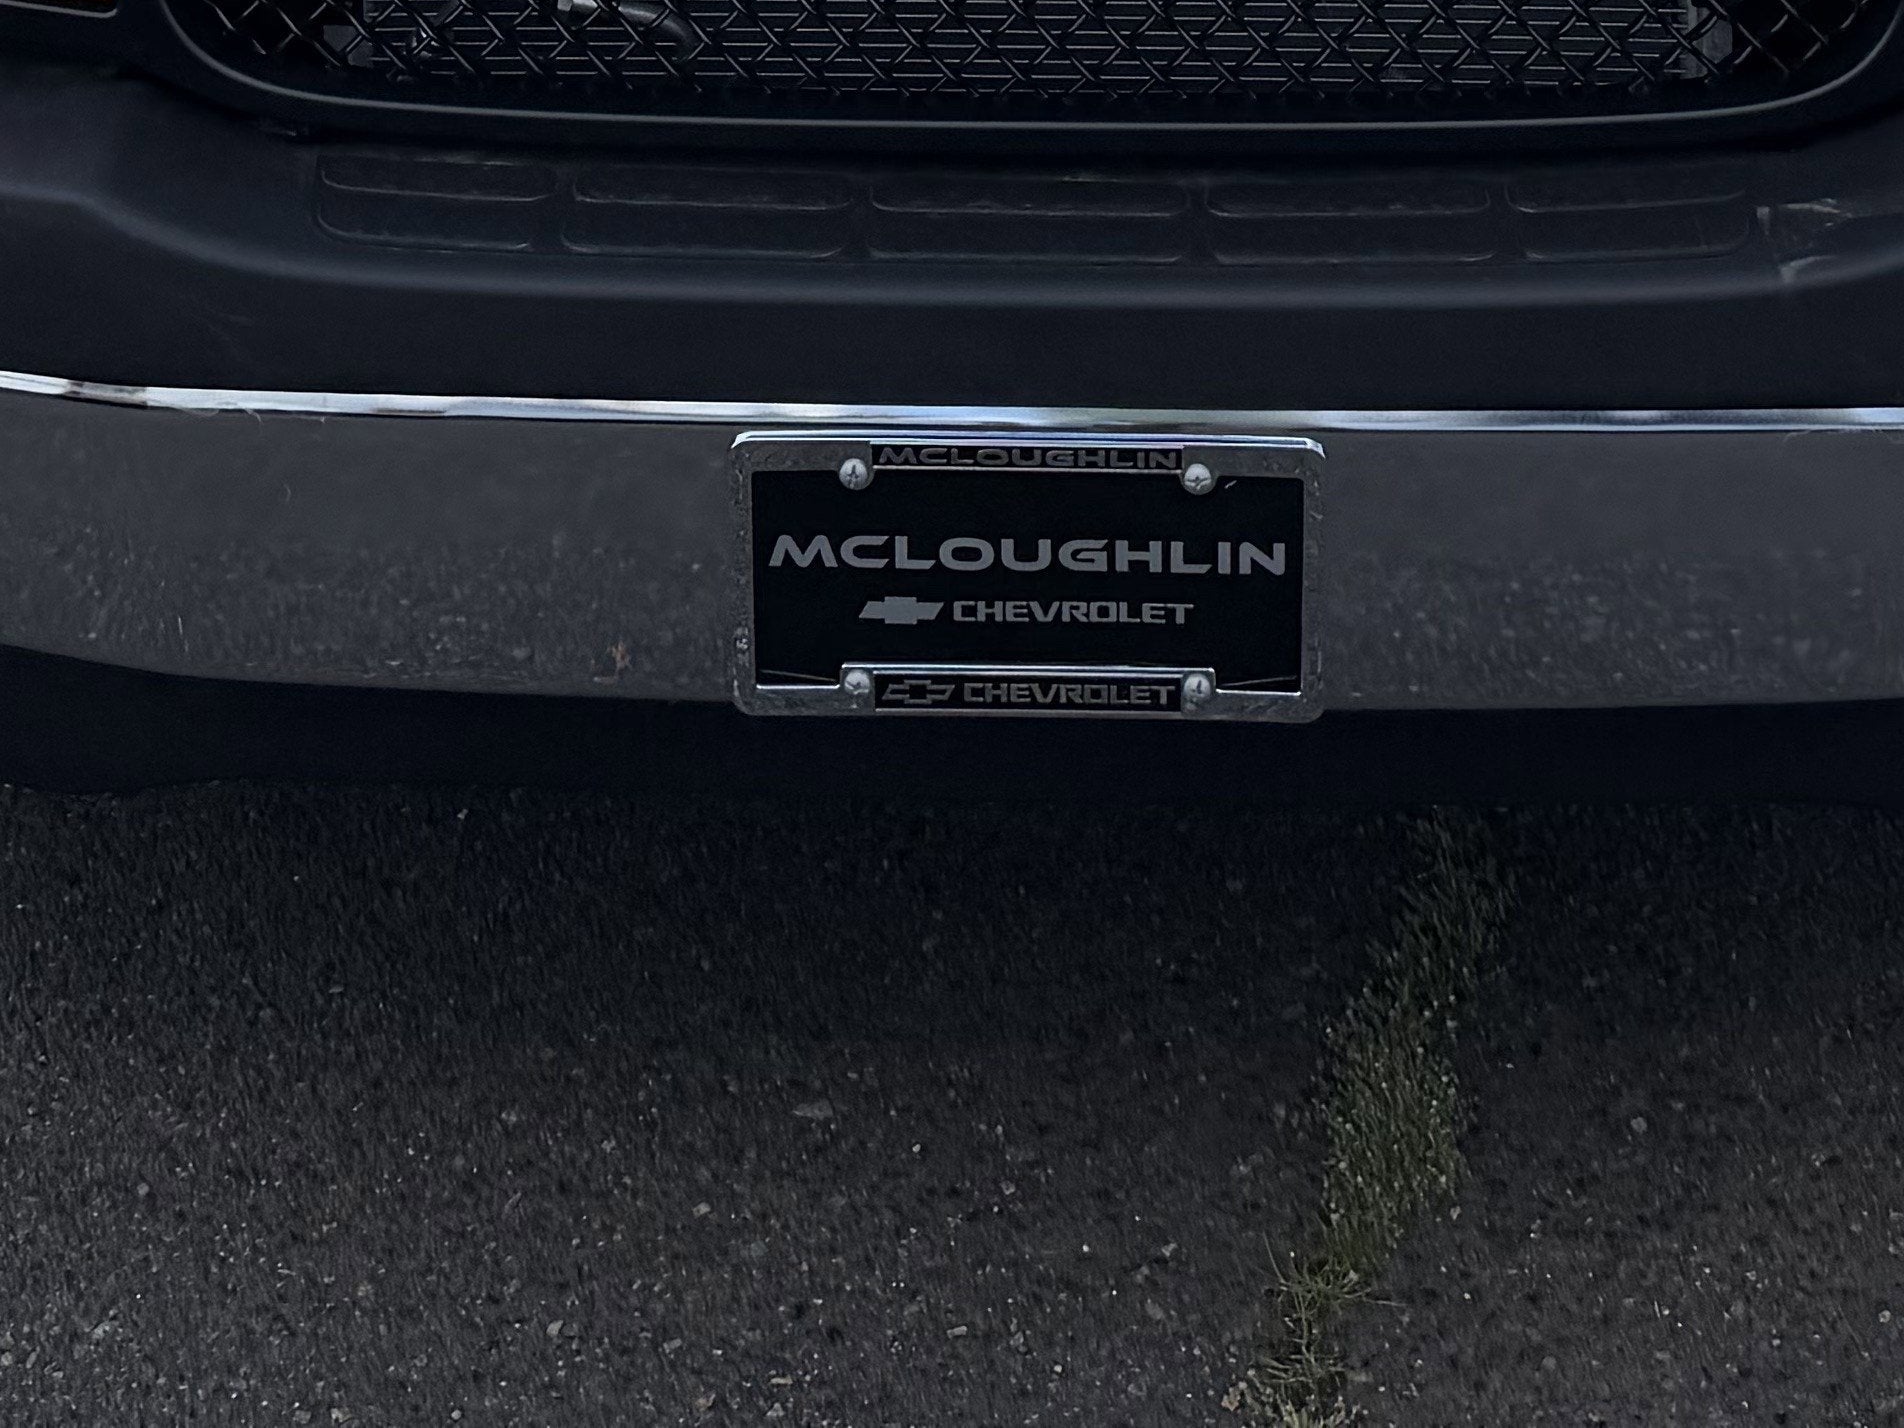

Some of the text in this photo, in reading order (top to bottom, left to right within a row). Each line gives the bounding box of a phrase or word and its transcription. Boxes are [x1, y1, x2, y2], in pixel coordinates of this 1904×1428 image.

[879, 447, 1177, 468] MCLOUGHLIN
[769, 534, 1286, 575] MCLOUGHLIN
[953, 601, 1194, 624] CHEVROLET
[963, 682, 1176, 705] CHEVROLET
